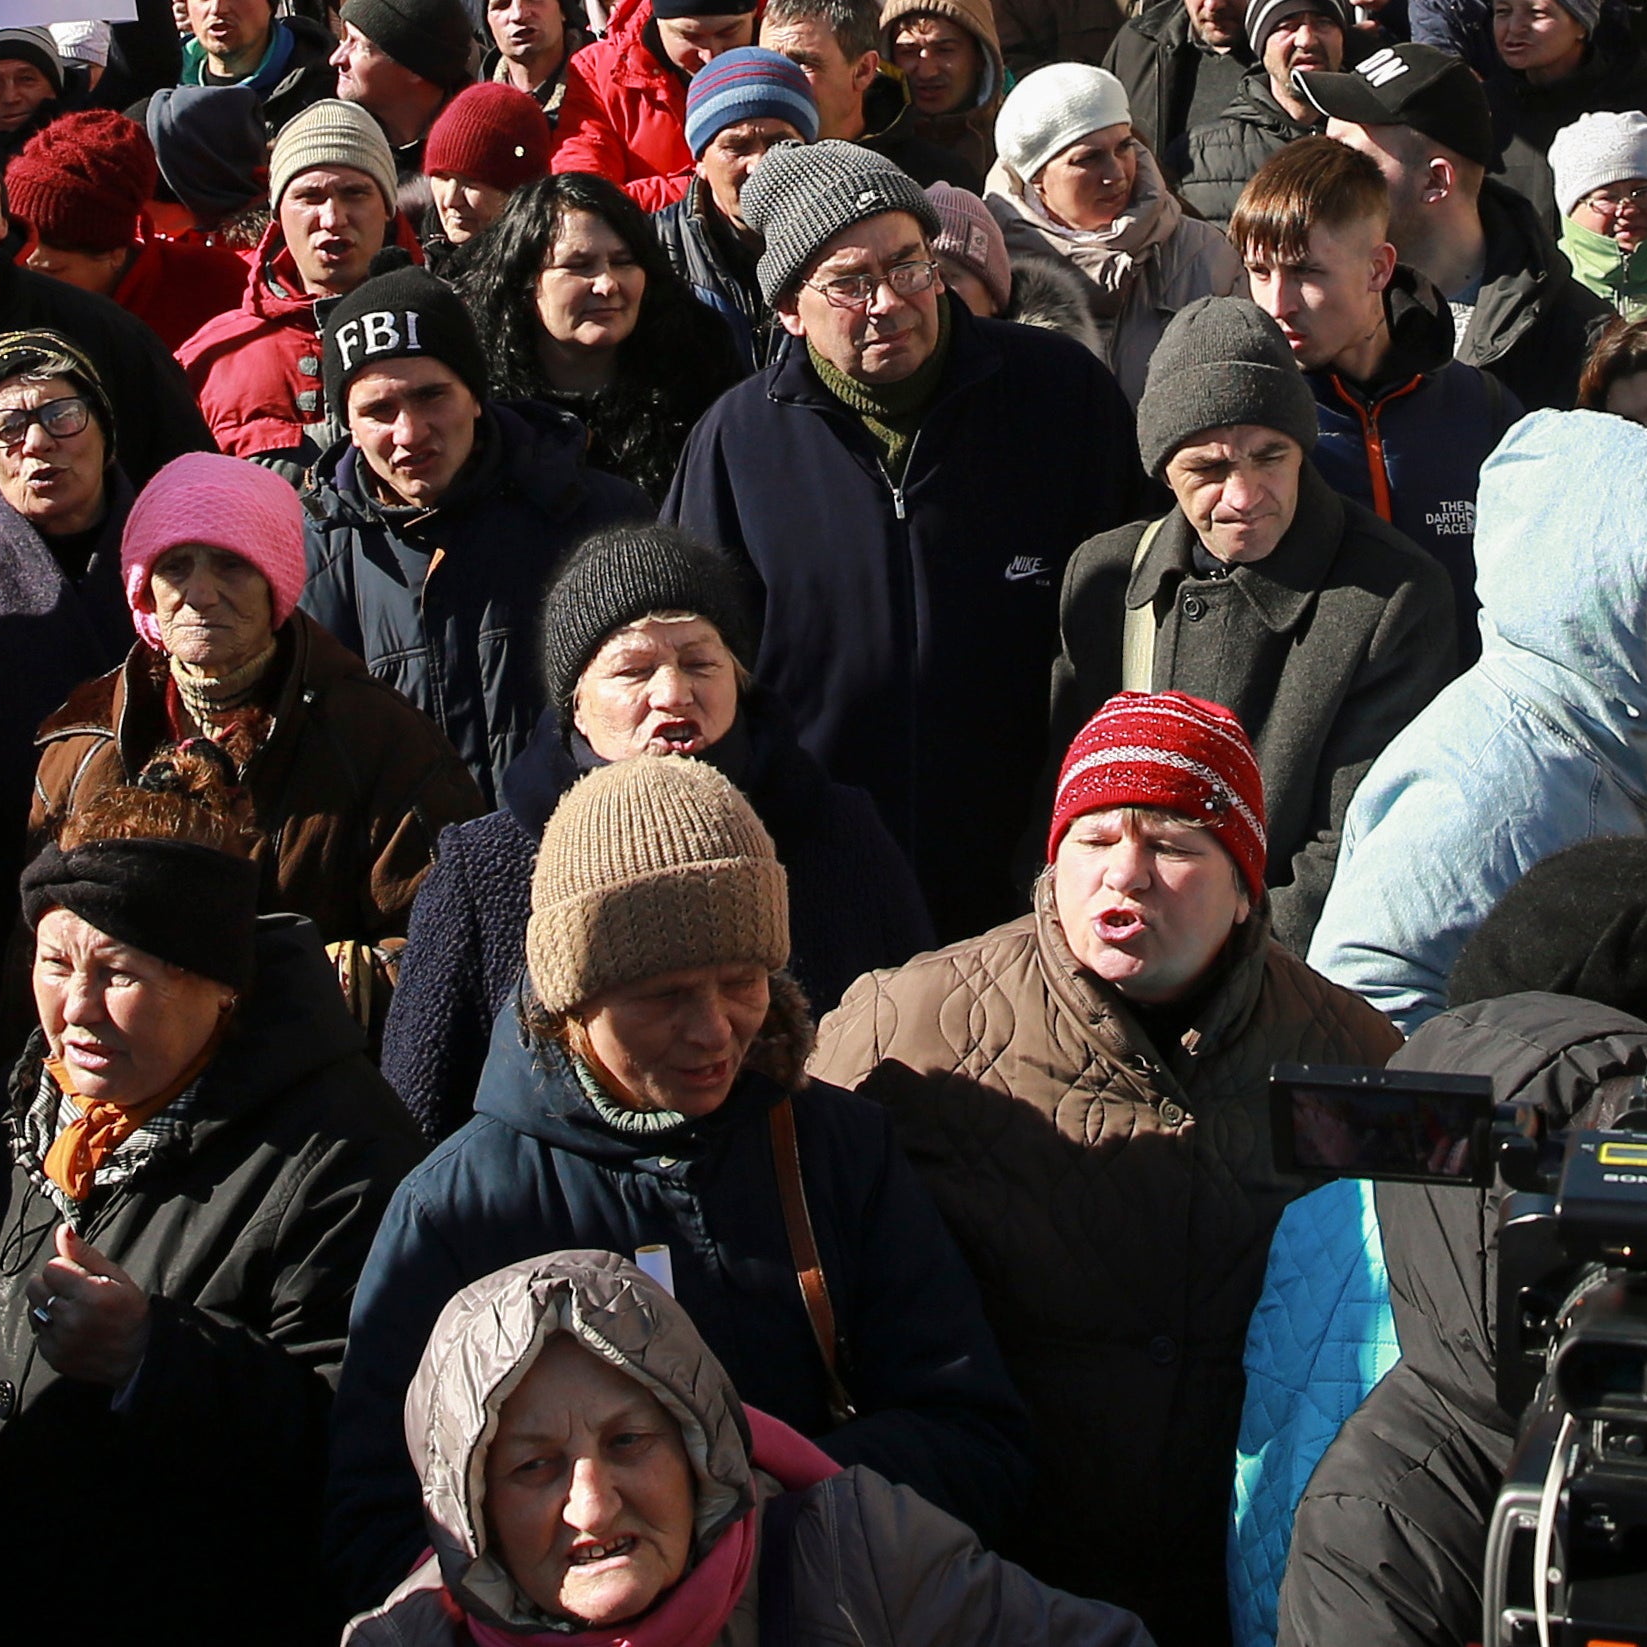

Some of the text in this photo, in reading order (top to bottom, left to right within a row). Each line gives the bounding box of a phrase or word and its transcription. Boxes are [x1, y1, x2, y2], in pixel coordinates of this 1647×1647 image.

[335, 310, 422, 371] FBI
[1439, 500, 1465, 512] THE
[1425, 512, 1466, 525] DARTH
[1436, 523, 1467, 535] FACE
[1011, 555, 1043, 572] NIKE
